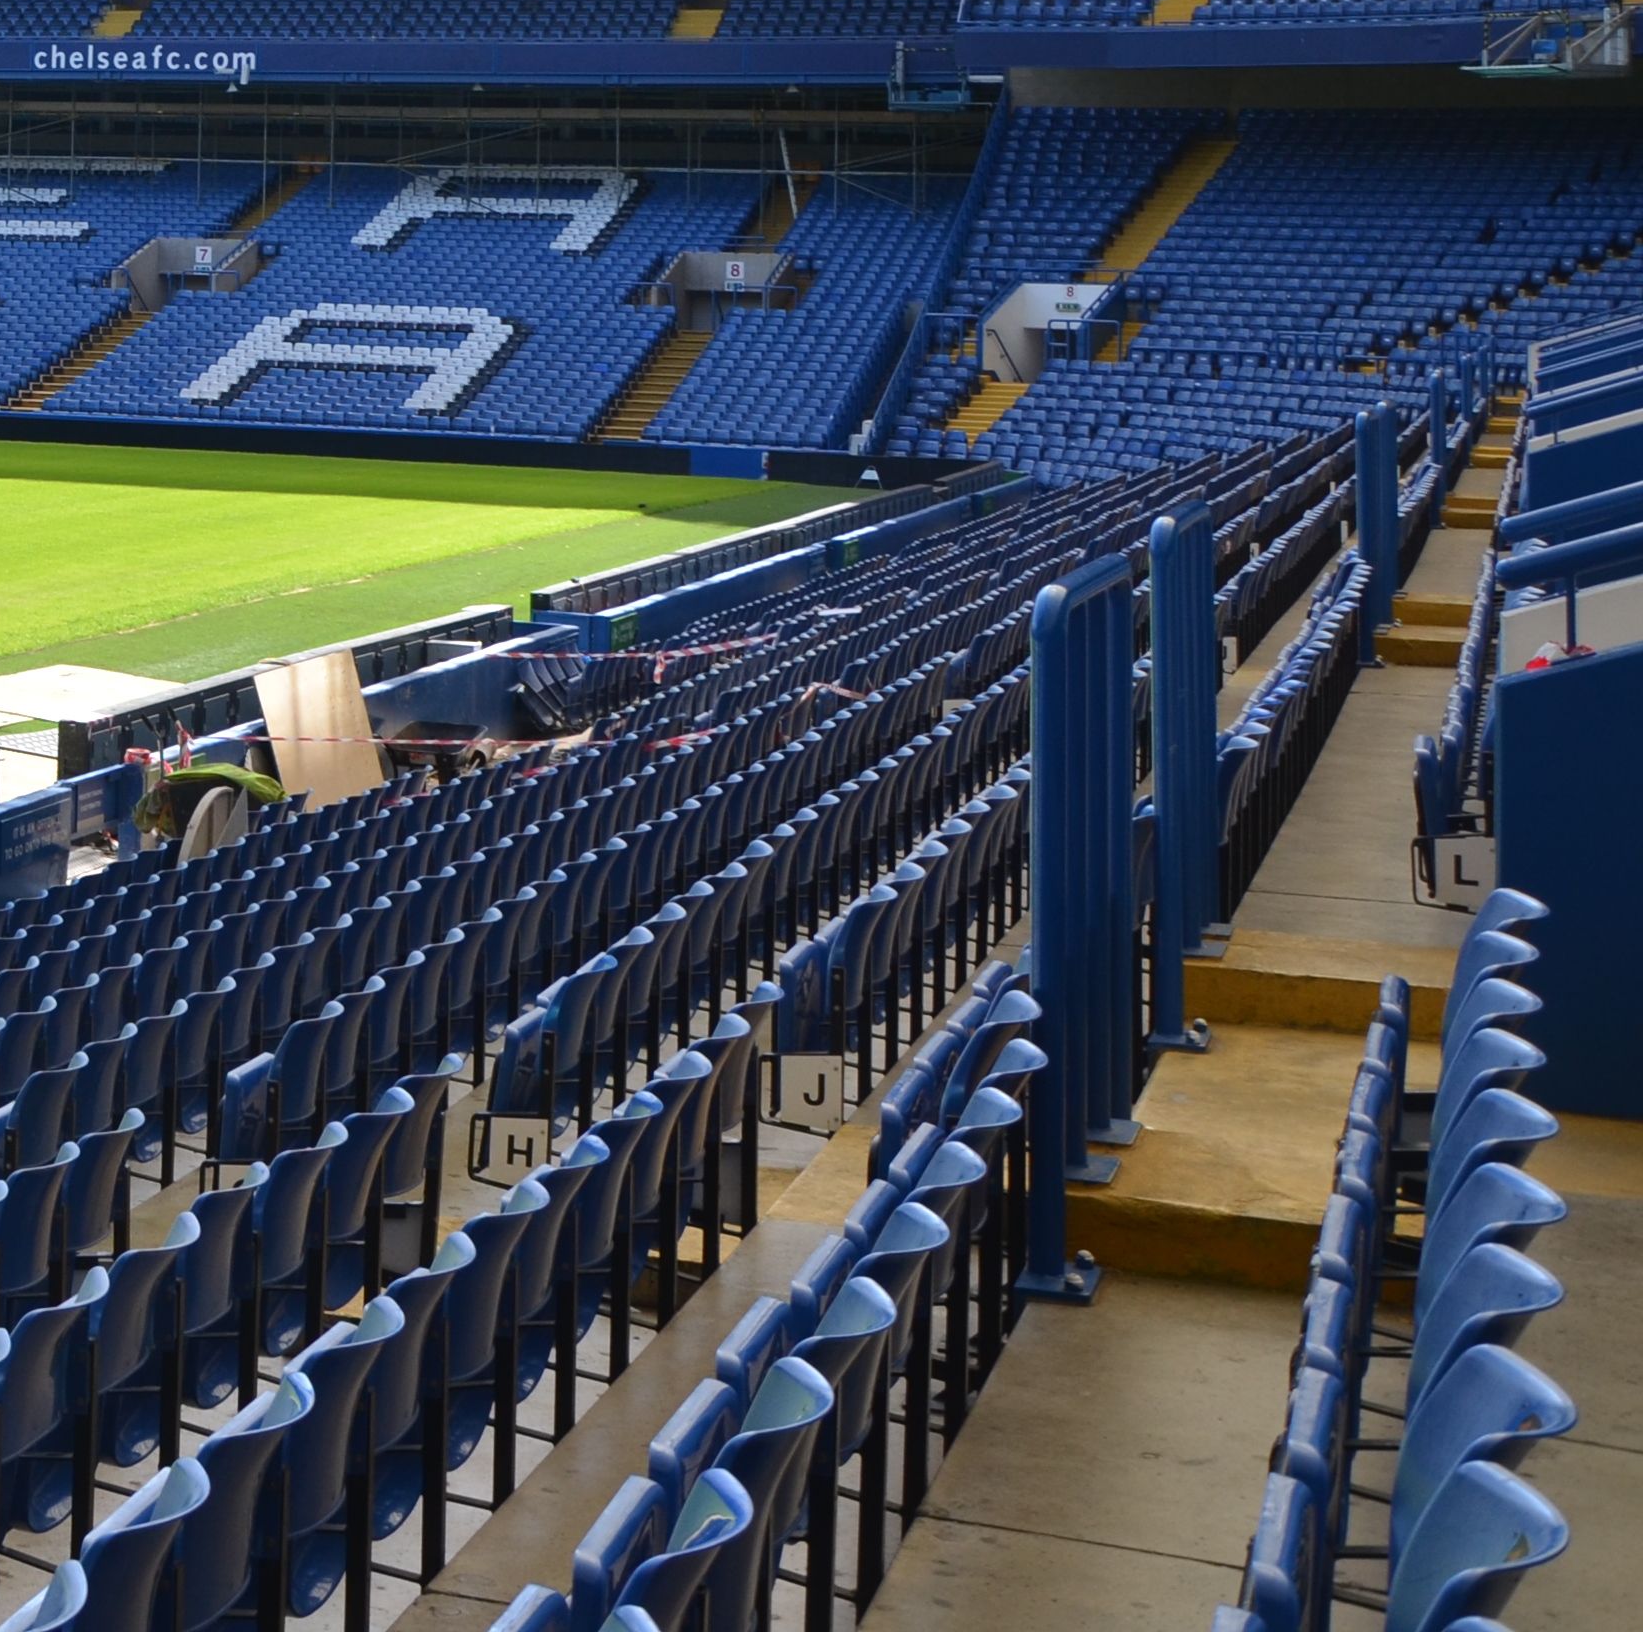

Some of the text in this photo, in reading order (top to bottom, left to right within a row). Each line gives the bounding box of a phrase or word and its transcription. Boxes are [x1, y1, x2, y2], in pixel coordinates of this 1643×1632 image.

[34, 44, 256, 70] chelseafc.com
[200, 249, 208, 261] 7
[731, 264, 740, 277] 8
[1067, 286, 1074, 297] 8
[1454, 854, 1479, 887] L
[802, 1072, 826, 1107] J
[507, 1136, 533, 1167] H
